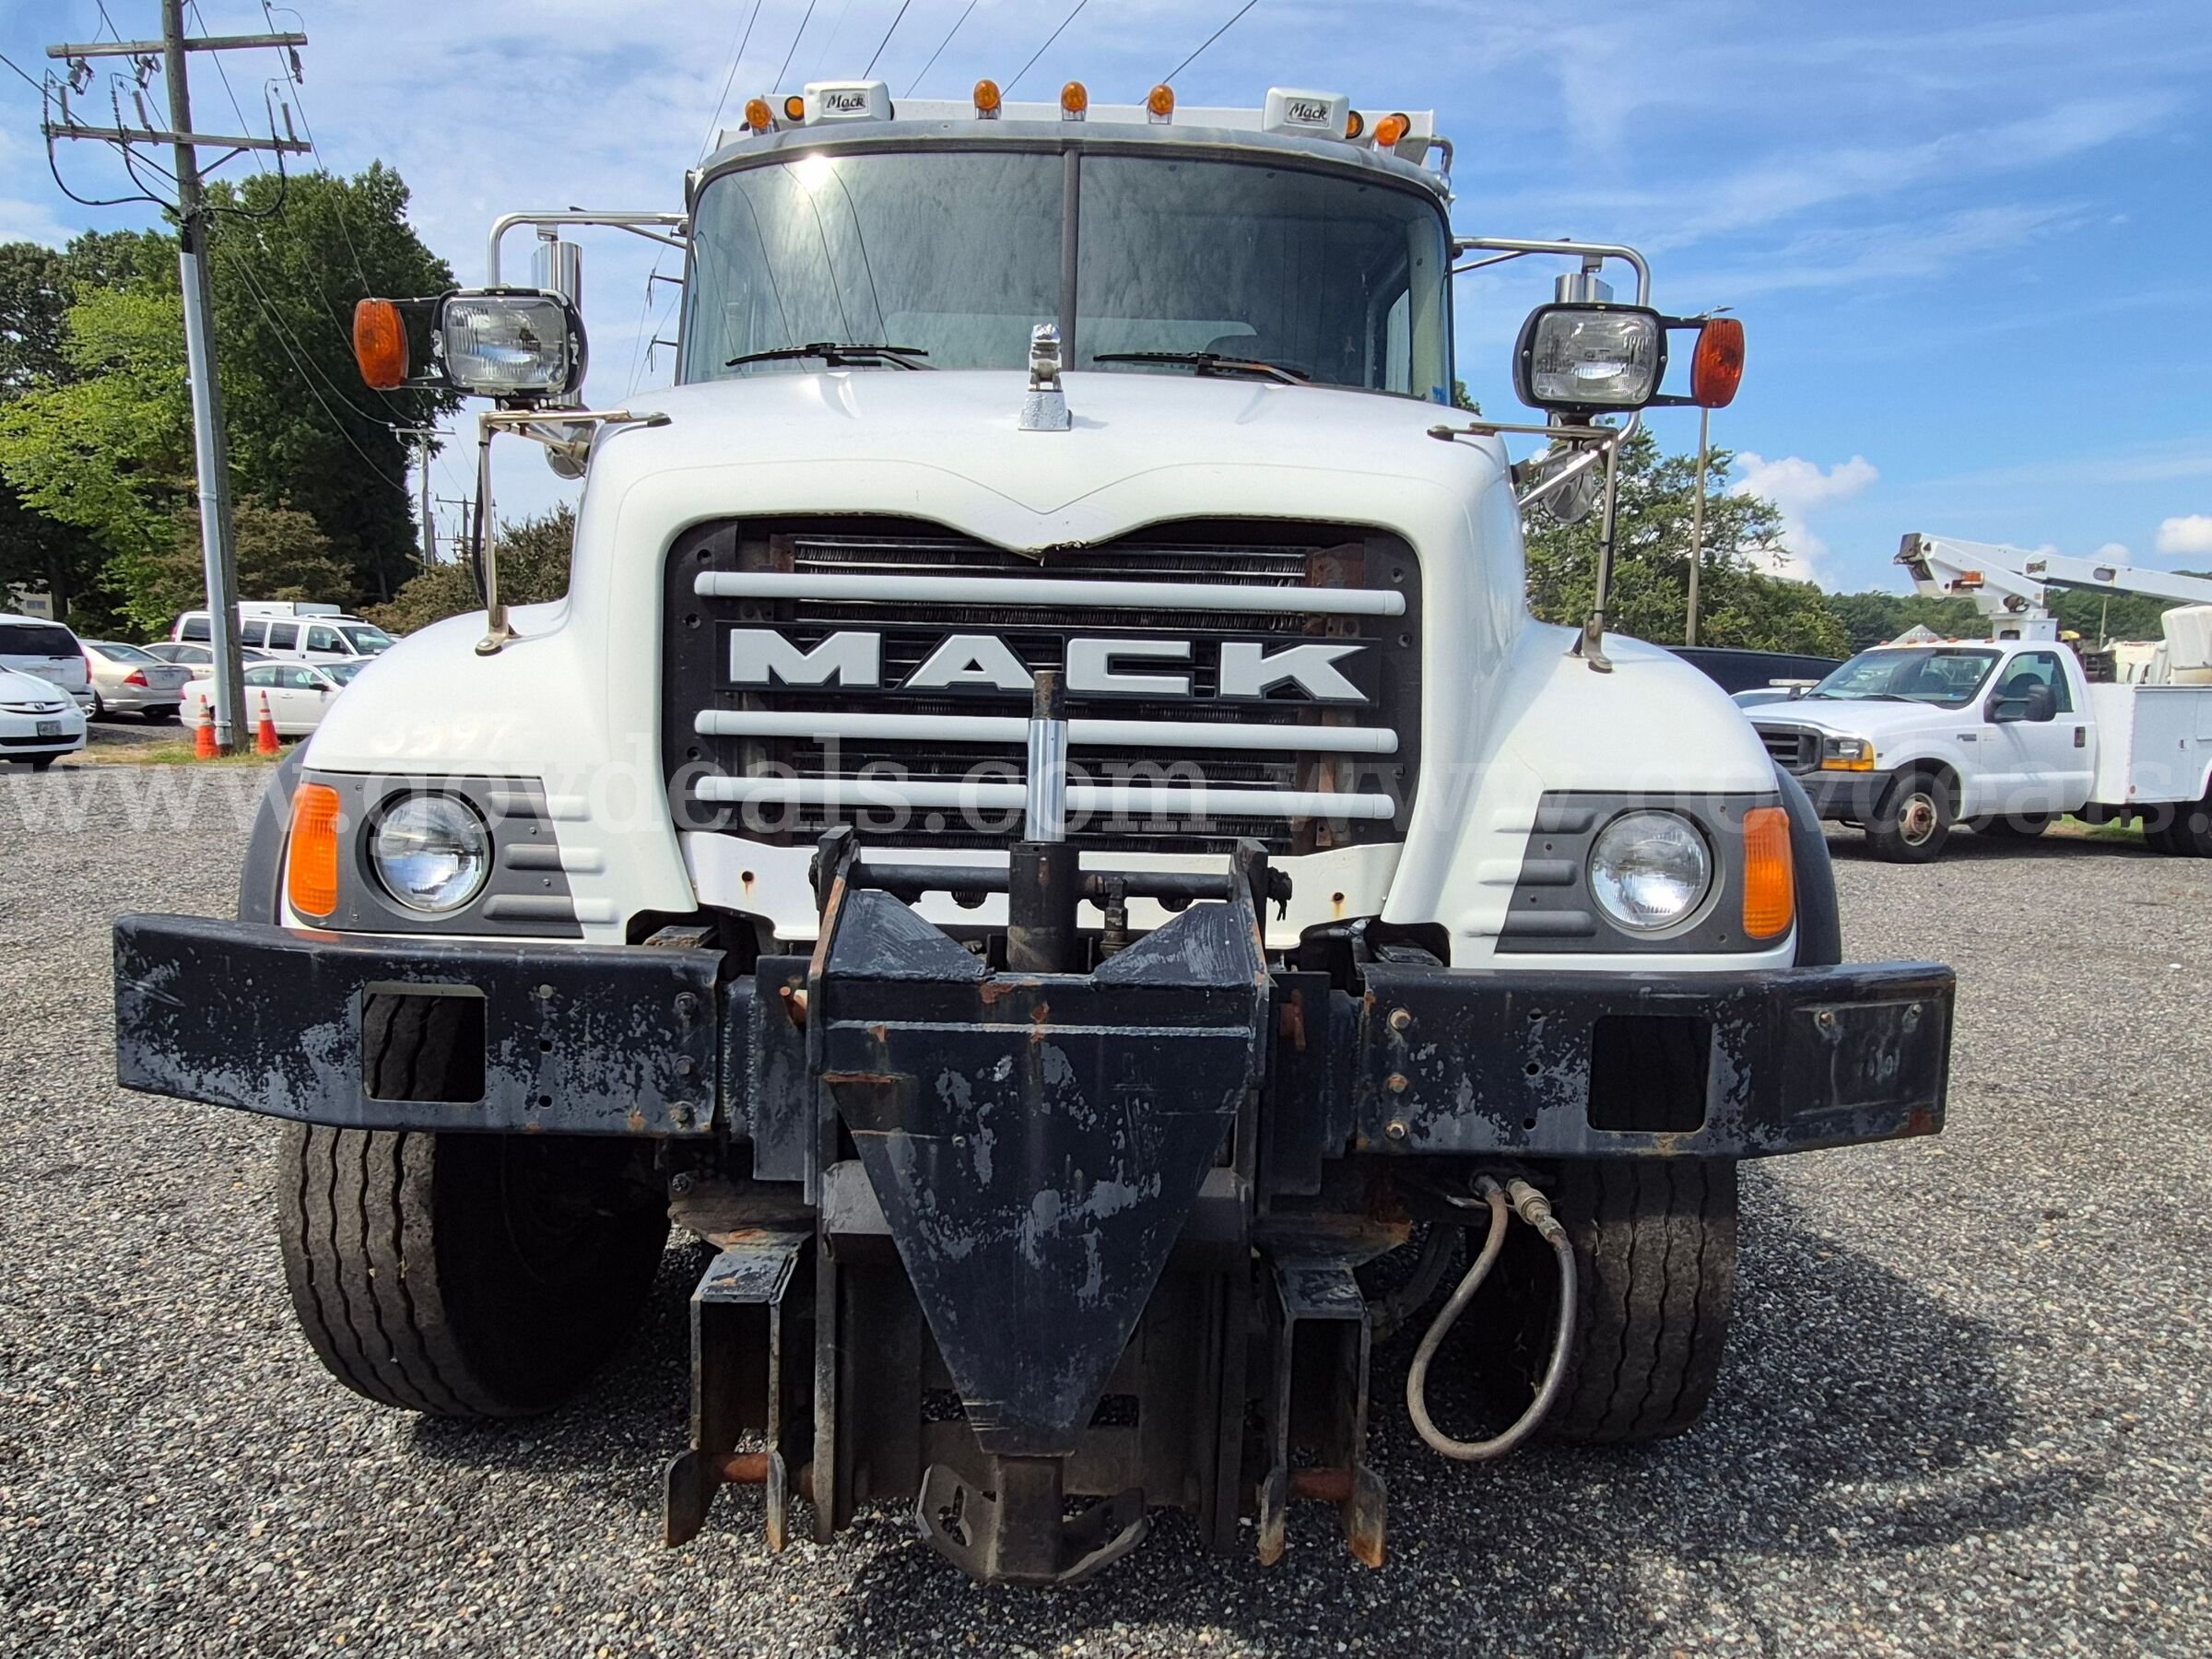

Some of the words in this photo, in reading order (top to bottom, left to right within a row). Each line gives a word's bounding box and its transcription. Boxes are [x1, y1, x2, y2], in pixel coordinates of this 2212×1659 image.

[826, 94, 866, 110] Mack
[1288, 102, 1328, 121] Mack
[729, 629, 1371, 701] MACK
